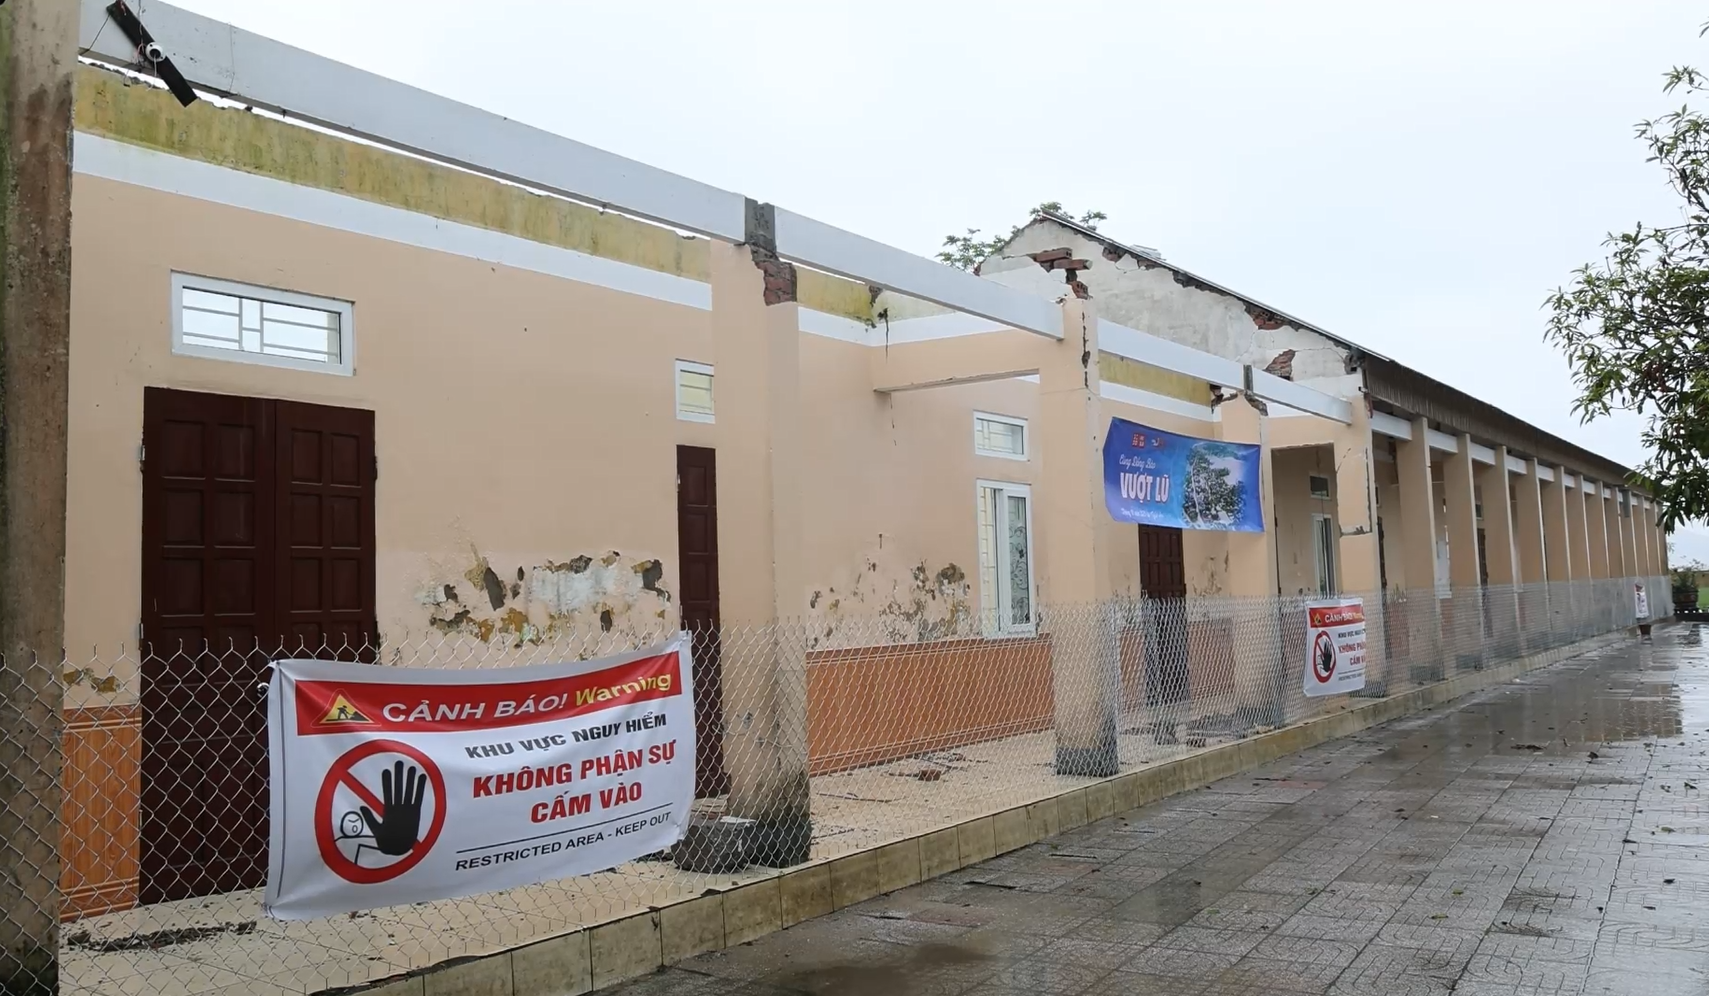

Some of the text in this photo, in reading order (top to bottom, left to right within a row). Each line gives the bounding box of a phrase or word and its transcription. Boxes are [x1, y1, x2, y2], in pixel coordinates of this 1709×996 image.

[1120, 472, 1169, 503] VƯỢT LŨ
[382, 673, 672, 723] CẢNH BÁO! Warning
[465, 711, 667, 759] KHU VỰC NGUY HIỂM
[473, 739, 677, 798] KHÔNG PHẬN SỰ
[531, 782, 642, 823] CẤM VÀO
[455, 841, 562, 871] RESTRICTED
[565, 832, 604, 850] AREA
[615, 820, 647, 837] KEEP
[650, 811, 671, 827] OUT
